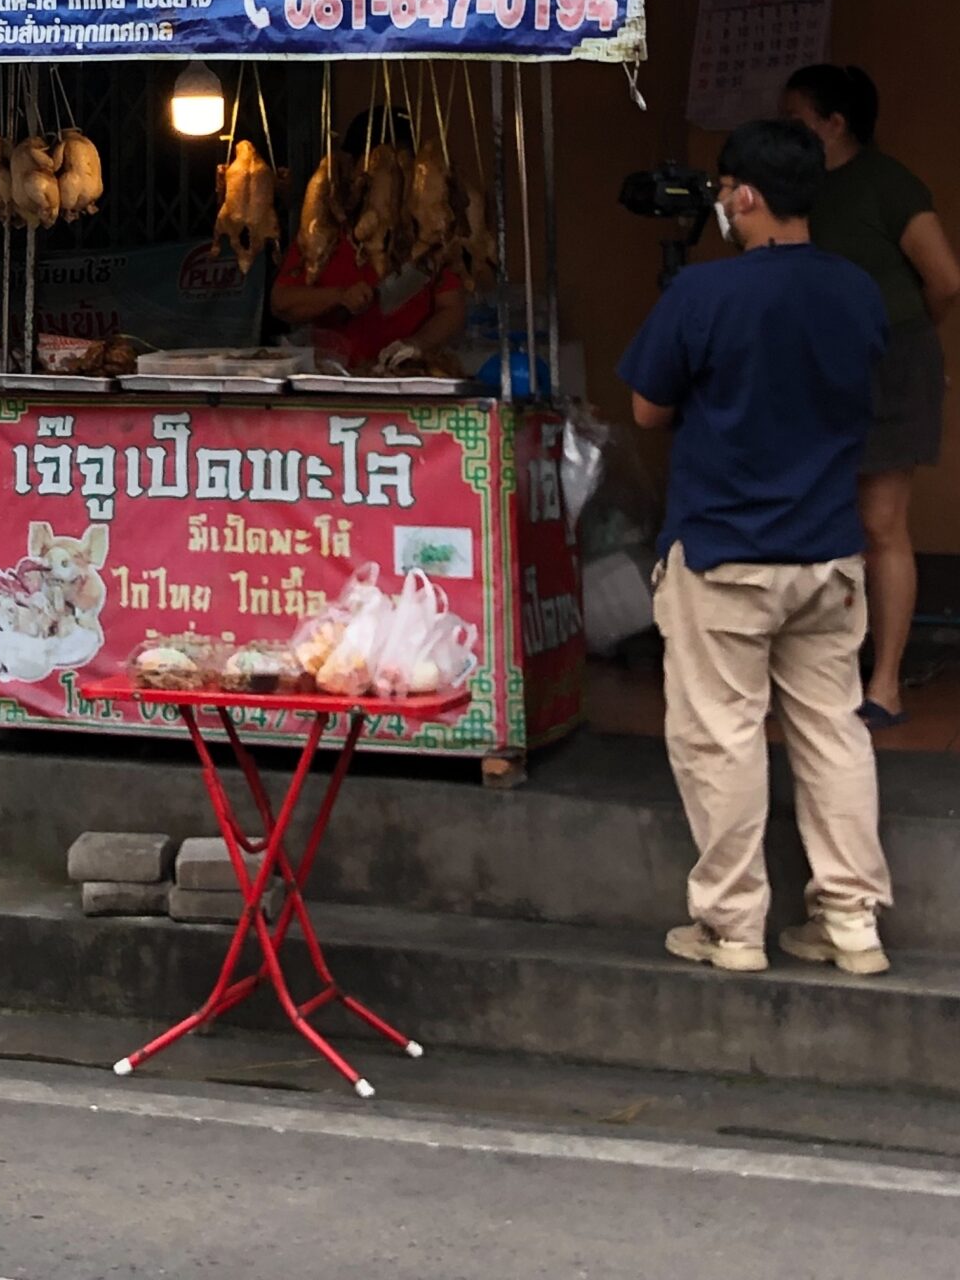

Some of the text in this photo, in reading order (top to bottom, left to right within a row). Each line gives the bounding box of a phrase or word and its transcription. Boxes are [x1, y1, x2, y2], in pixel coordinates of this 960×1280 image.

[12, 411, 423, 522] เจ๊จูเป็ดพะโล้
[111, 566, 212, 613] ไก่ไทย
